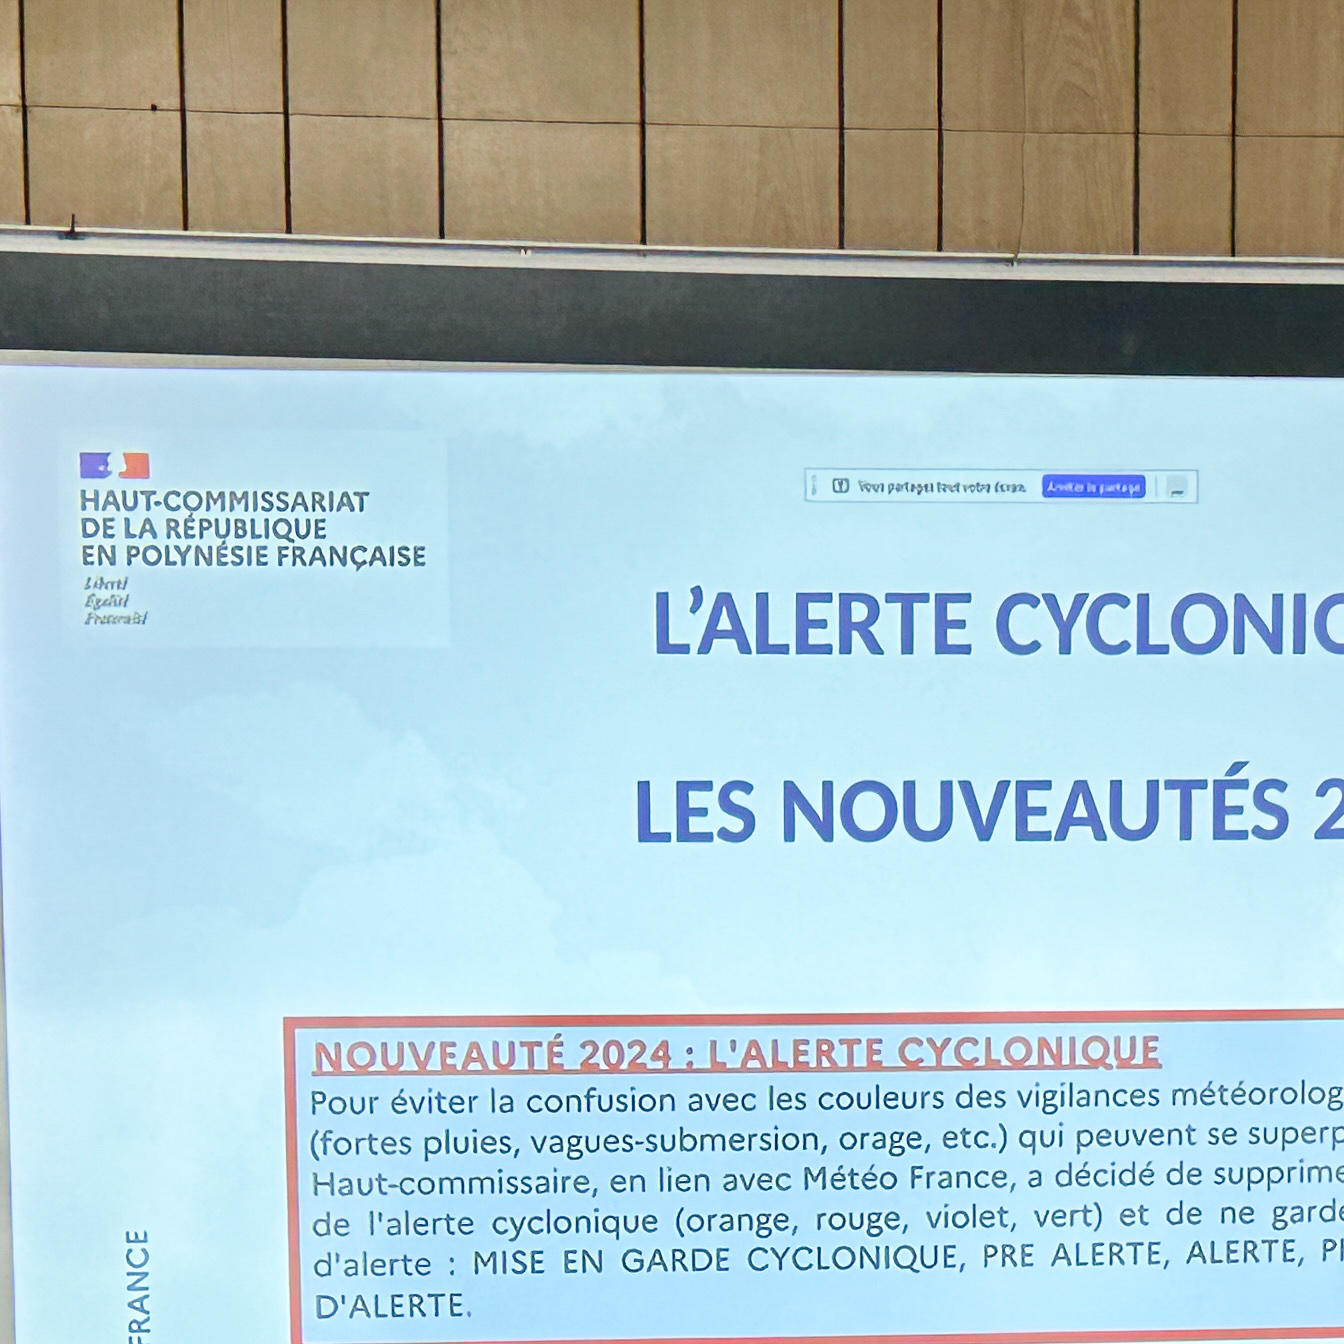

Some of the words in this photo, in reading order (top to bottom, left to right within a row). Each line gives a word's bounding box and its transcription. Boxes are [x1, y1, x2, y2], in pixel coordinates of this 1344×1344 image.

[80, 488, 371, 513] HAUT-COMMISSARIAT
[80, 516, 116, 540] DE
[123, 516, 158, 540] LA
[163, 512, 329, 543] RÉPUBLIQUE
[82, 544, 117, 567] EN
[125, 540, 269, 567] POLYNÉSIE
[276, 545, 427, 571] FRANÇAISE
[636, 779, 756, 844] LES
[783, 760, 1290, 843] NOUVEAUTÉS
[315, 1034, 565, 1072] NOUVEAUTÉ
[580, 1039, 672, 1069] 2024
[710, 1038, 884, 1069] L'ALERTE
[898, 1035, 1161, 1069] CYCLONIQUE
[311, 1090, 380, 1116] Pour
[390, 1087, 479, 1115] éviter
[490, 1087, 514, 1114] la
[526, 1086, 676, 1114] confusion
[688, 1092, 757, 1113] avec
[769, 1084, 807, 1111] les
[818, 1083, 945, 1111] couleurs
[955, 1082, 1007, 1110] des
[1016, 1081, 1160, 1116] vigilances
[310, 1129, 412, 1162] (fortes
[424, 1128, 520, 1163] pluies,
[530, 1124, 828, 1161] vagues-submersion,
[839, 1130, 931, 1158] orage,
[942, 1122, 1008, 1155] etc.)
[1018, 1121, 1064, 1156] qui
[1076, 1123, 1197, 1155] peuvent
[1207, 1127, 1238, 1146] se
[312, 1166, 598, 1199] Haut-commissaire,
[610, 1174, 646, 1194] en
[659, 1166, 710, 1193] lien
[722, 1172, 792, 1192] avec
[803, 1163, 898, 1191] Météo
[910, 1165, 1017, 1193] France,
[1027, 1169, 1043, 1189] a
[1055, 1160, 1155, 1188] décidé
[1165, 1160, 1203, 1186] de
[312, 1211, 351, 1238] de
[369, 1209, 475, 1237] l'alerte
[491, 1207, 658, 1243] cyclonique
[675, 1206, 798, 1239] (orange,
[816, 1210, 909, 1238] rouge,
[925, 1203, 1017, 1233] violet,
[1033, 1201, 1103, 1233] vert)
[1119, 1204, 1150, 1227] et
[1165, 1199, 1203, 1226] de
[1220, 1205, 1255, 1225] ne
[313, 1250, 432, 1278] d'alerte
[474, 1249, 545, 1276] MISE
[563, 1249, 603, 1274] EN
[621, 1247, 730, 1274] GARDE
[747, 1244, 966, 1274] CYCLONIQUE,
[983, 1243, 1035, 1269] PRE
[1050, 1241, 1170, 1271] ALERTE,
[1185, 1238, 1304, 1268] ALERTE,
[315, 1292, 472, 1320] D'ALERTE.
